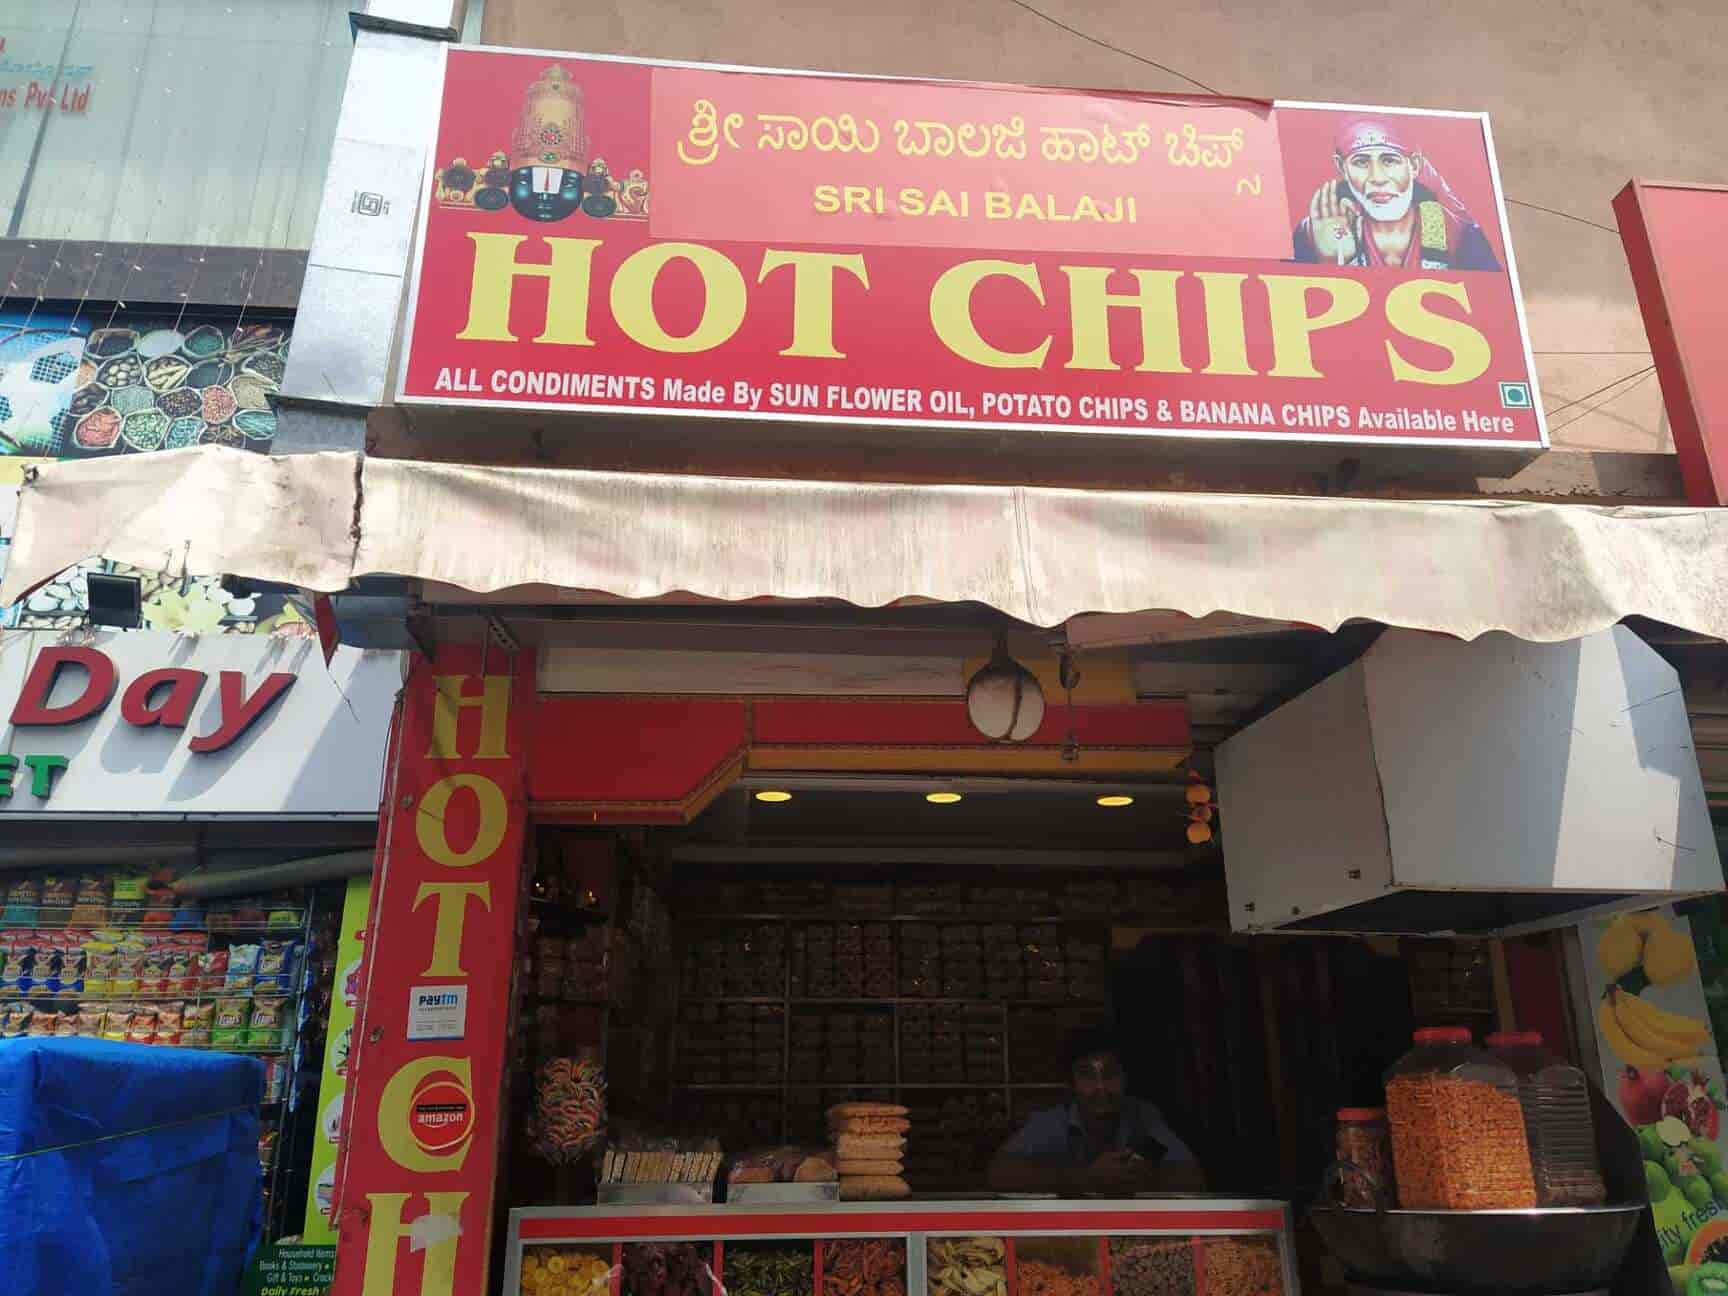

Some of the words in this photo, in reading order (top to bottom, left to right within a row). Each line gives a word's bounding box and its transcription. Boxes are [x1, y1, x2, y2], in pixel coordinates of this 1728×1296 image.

[60, 82, 91, 112] Ltd
[677, 99, 744, 165] ಶ್ರೀ
[757, 113, 880, 153] ಸಾಯಿ
[1040, 123, 1151, 163] ಹಾಟ್
[814, 184, 885, 215] SRI
[899, 187, 970, 218] SAI
[984, 191, 1137, 224] BALAJI
[455, 231, 871, 360] HOT
[929, 258, 1493, 387] CHIPS
[434, 367, 483, 392] ALL
[491, 369, 656, 400] CONDIMENTS
[663, 378, 725, 404] Made
[733, 381, 763, 411] By
[769, 382, 819, 408] SUN
[826, 385, 923, 413] FLOWER
[930, 390, 975, 419] OIL,
[982, 392, 1072, 419] POTATO
[1079, 396, 1149, 421] CHIPS
[1156, 399, 1173, 423] &
[1180, 400, 1276, 426] BANANA
[1281, 403, 1351, 428] CHIPS
[1358, 406, 1457, 433] Available
[1462, 410, 1515, 433] Here
[9, 645, 298, 754] Day
[410, 674, 512, 977] HOT
[416, 1111, 464, 1127] amazon
